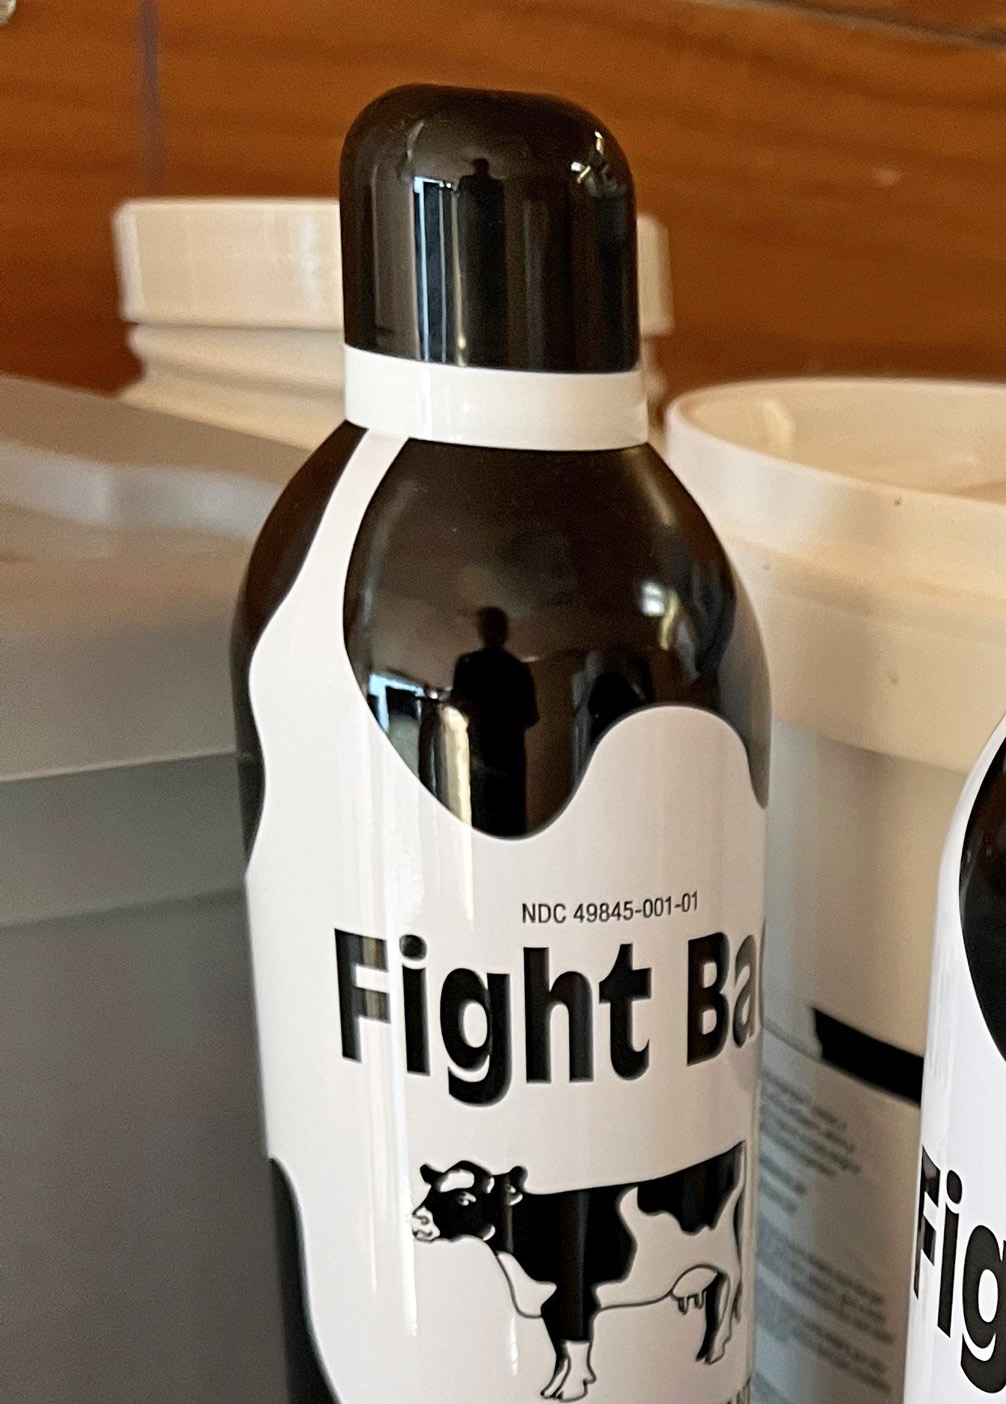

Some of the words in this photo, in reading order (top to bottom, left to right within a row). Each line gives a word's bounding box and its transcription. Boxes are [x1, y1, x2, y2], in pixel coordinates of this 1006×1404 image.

[522, 902, 567, 924] NDC
[573, 891, 699, 922] 49845-001-01
[334, 928, 652, 1107] Fight
